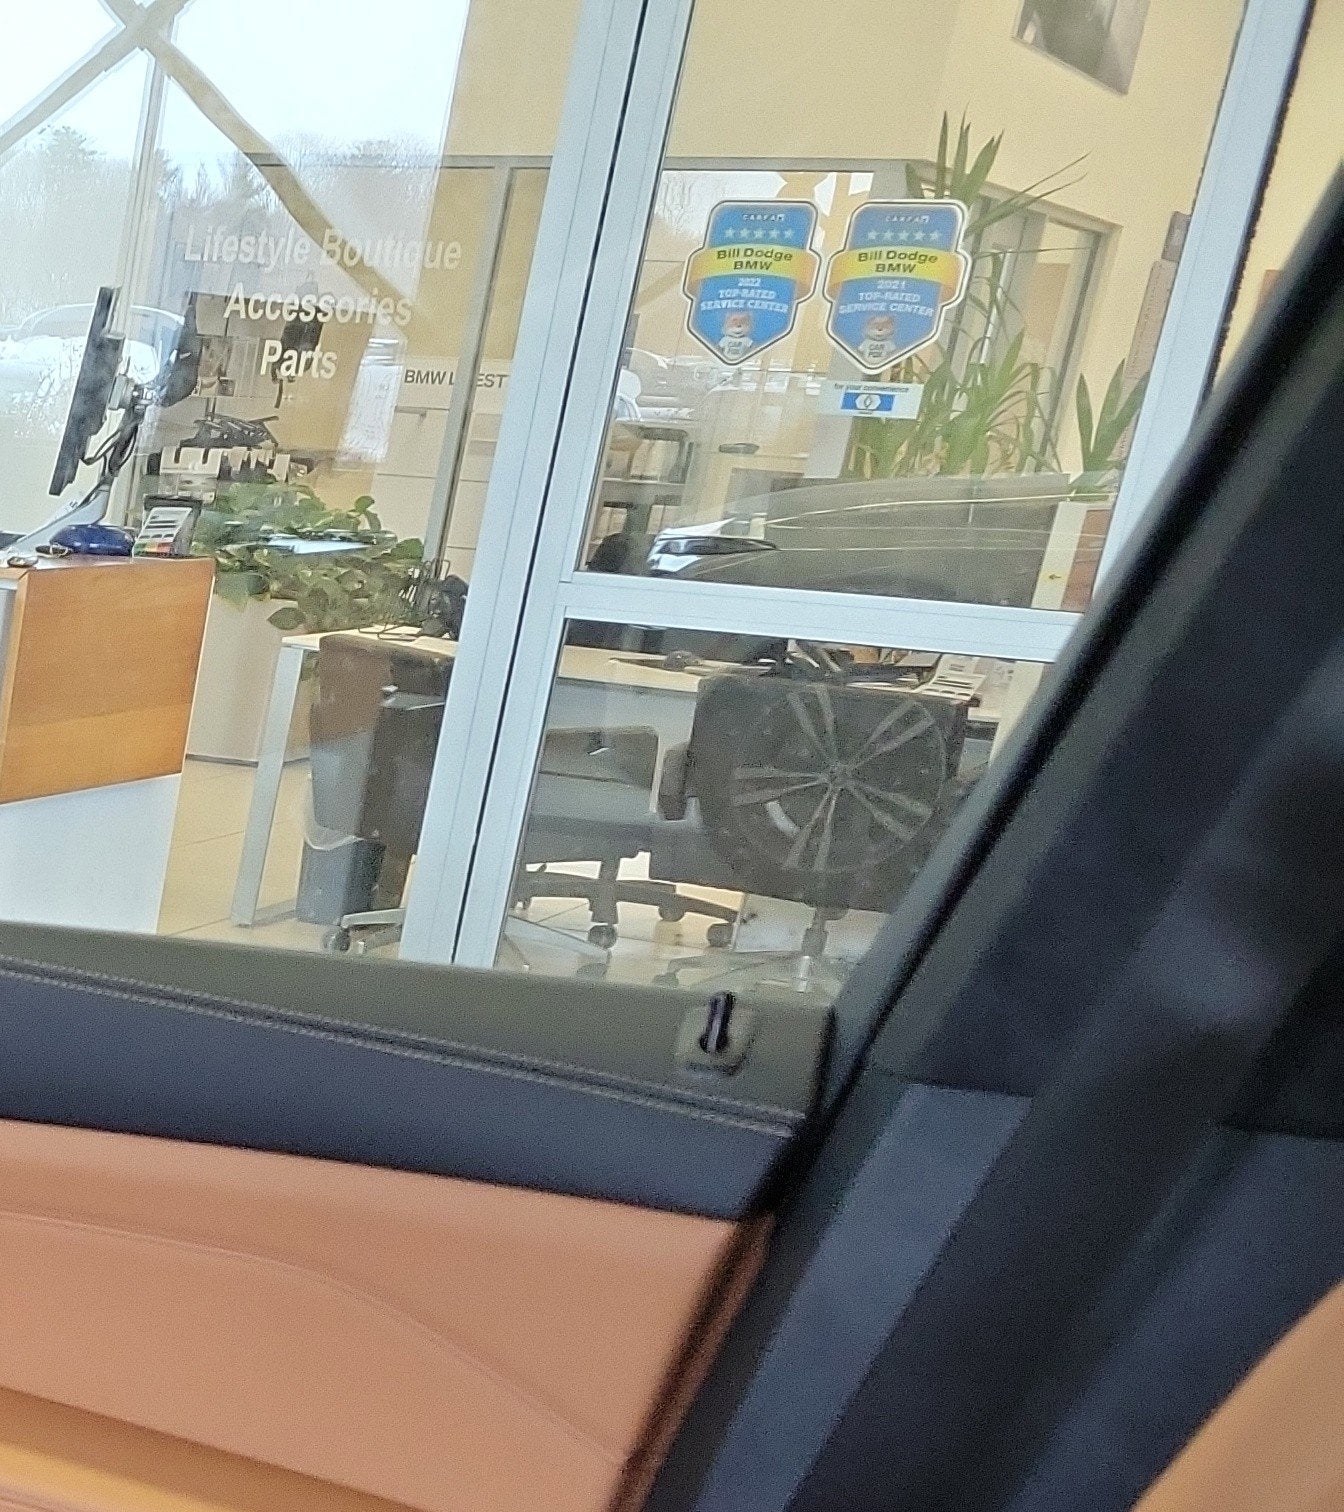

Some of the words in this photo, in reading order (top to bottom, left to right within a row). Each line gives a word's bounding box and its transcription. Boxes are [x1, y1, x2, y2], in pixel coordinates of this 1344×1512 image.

[184, 224, 311, 273] Lifestyle
[320, 229, 462, 271] Boutique
[717, 248, 740, 260] Bill
[743, 248, 793, 262] Dodge
[858, 251, 883, 263] Bill
[886, 251, 938, 264] Dodge
[733, 260, 773, 271] BMW
[875, 263, 917, 273] BMW
[223, 282, 412, 327] Accessories
[700, 299, 746, 311] SERVICE
[747, 299, 789, 312] CENTER
[839, 302, 887, 314] SERVICE
[889, 303, 934, 317] CENTER
[260, 339, 338, 380] Parts
[404, 369, 446, 385] BMW
